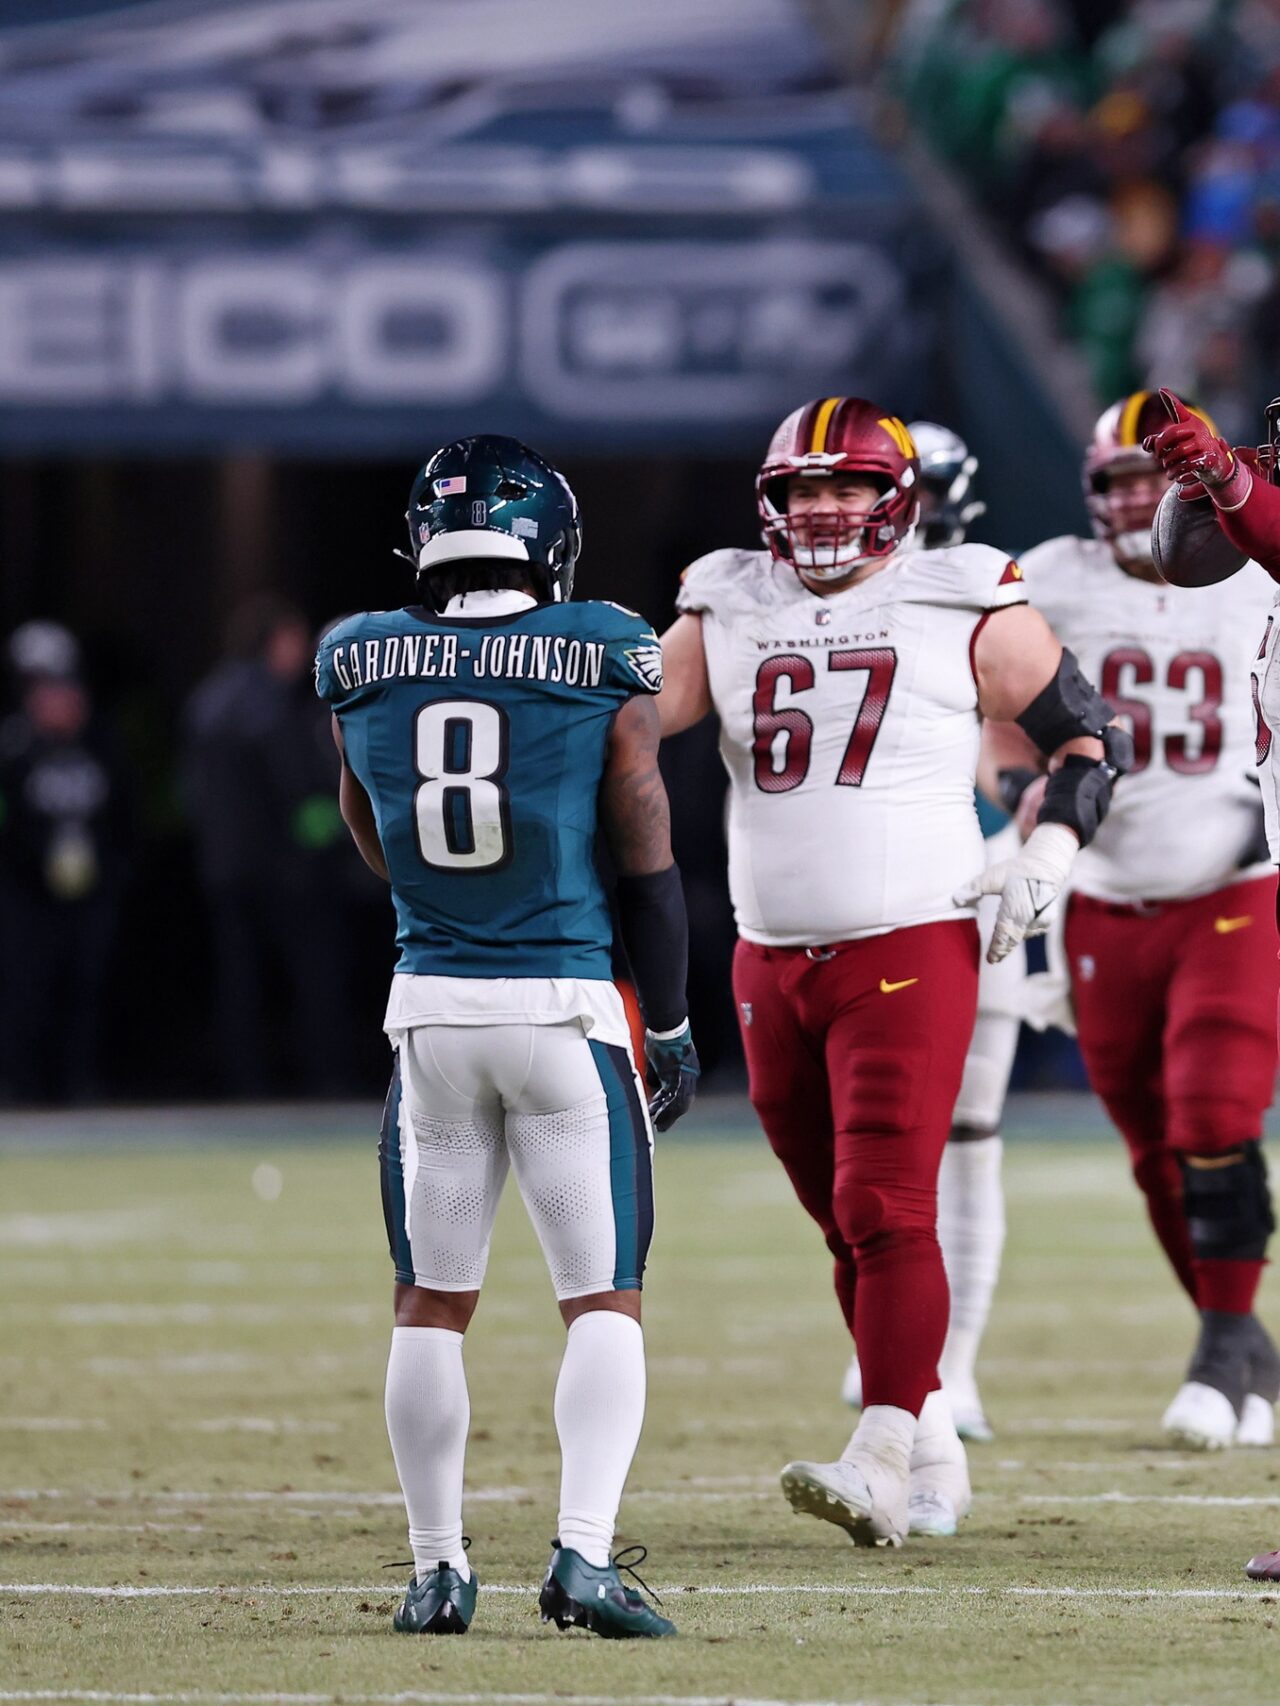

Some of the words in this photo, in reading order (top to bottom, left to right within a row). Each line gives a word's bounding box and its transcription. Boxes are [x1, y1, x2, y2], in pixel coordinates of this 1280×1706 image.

[472, 500, 487, 526] 8
[332, 633, 607, 691] GARDNER-JOHNSON
[757, 630, 889, 650] WASHINGTON
[752, 647, 898, 793] 67
[1099, 645, 1224, 777] 63
[413, 698, 512, 873] 8
